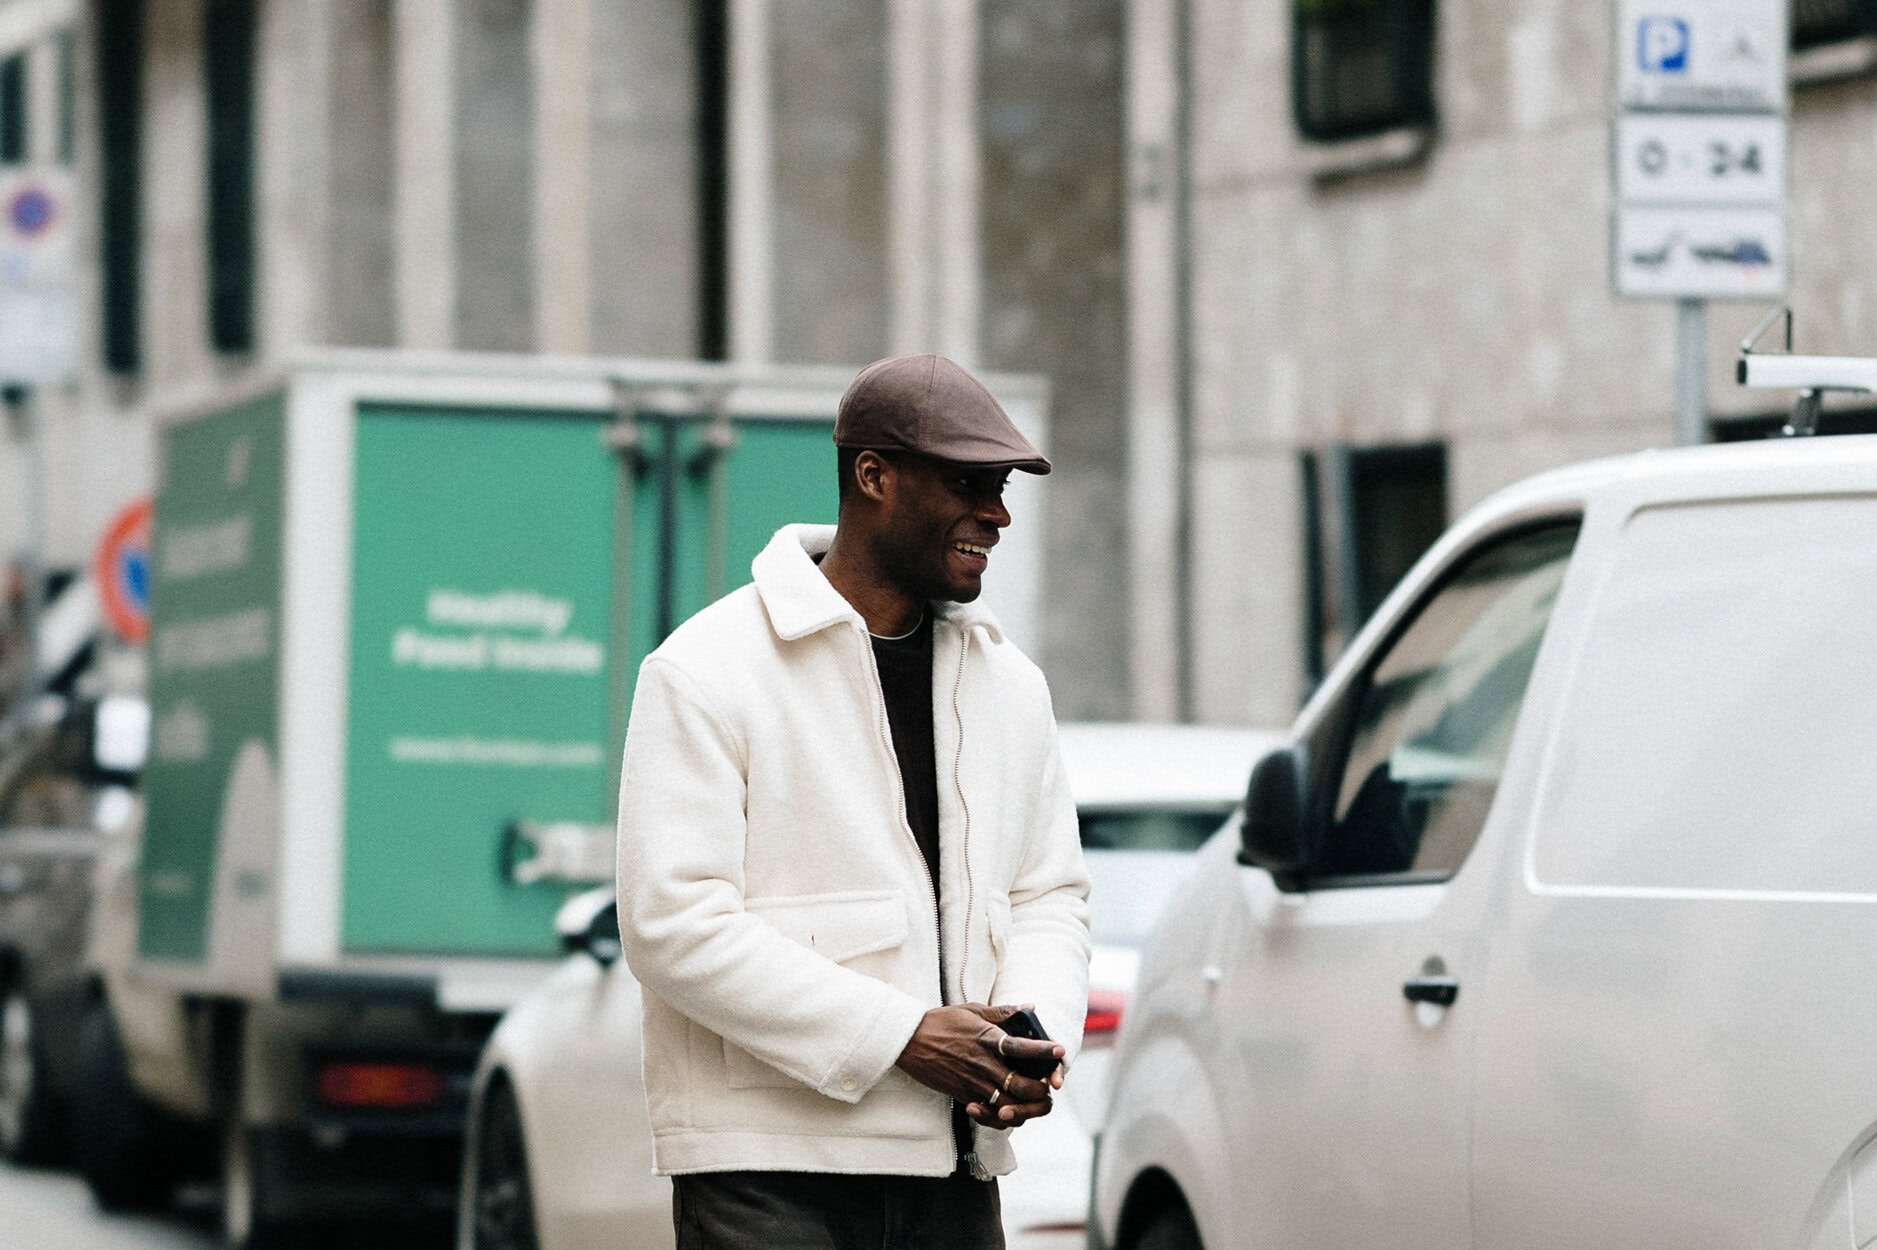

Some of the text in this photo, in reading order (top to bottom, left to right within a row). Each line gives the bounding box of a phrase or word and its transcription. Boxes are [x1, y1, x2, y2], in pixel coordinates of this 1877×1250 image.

[1645, 23, 1681, 71] P
[1709, 140, 1763, 177] 24
[427, 589, 573, 636] Healthy
[391, 628, 488, 668] Food
